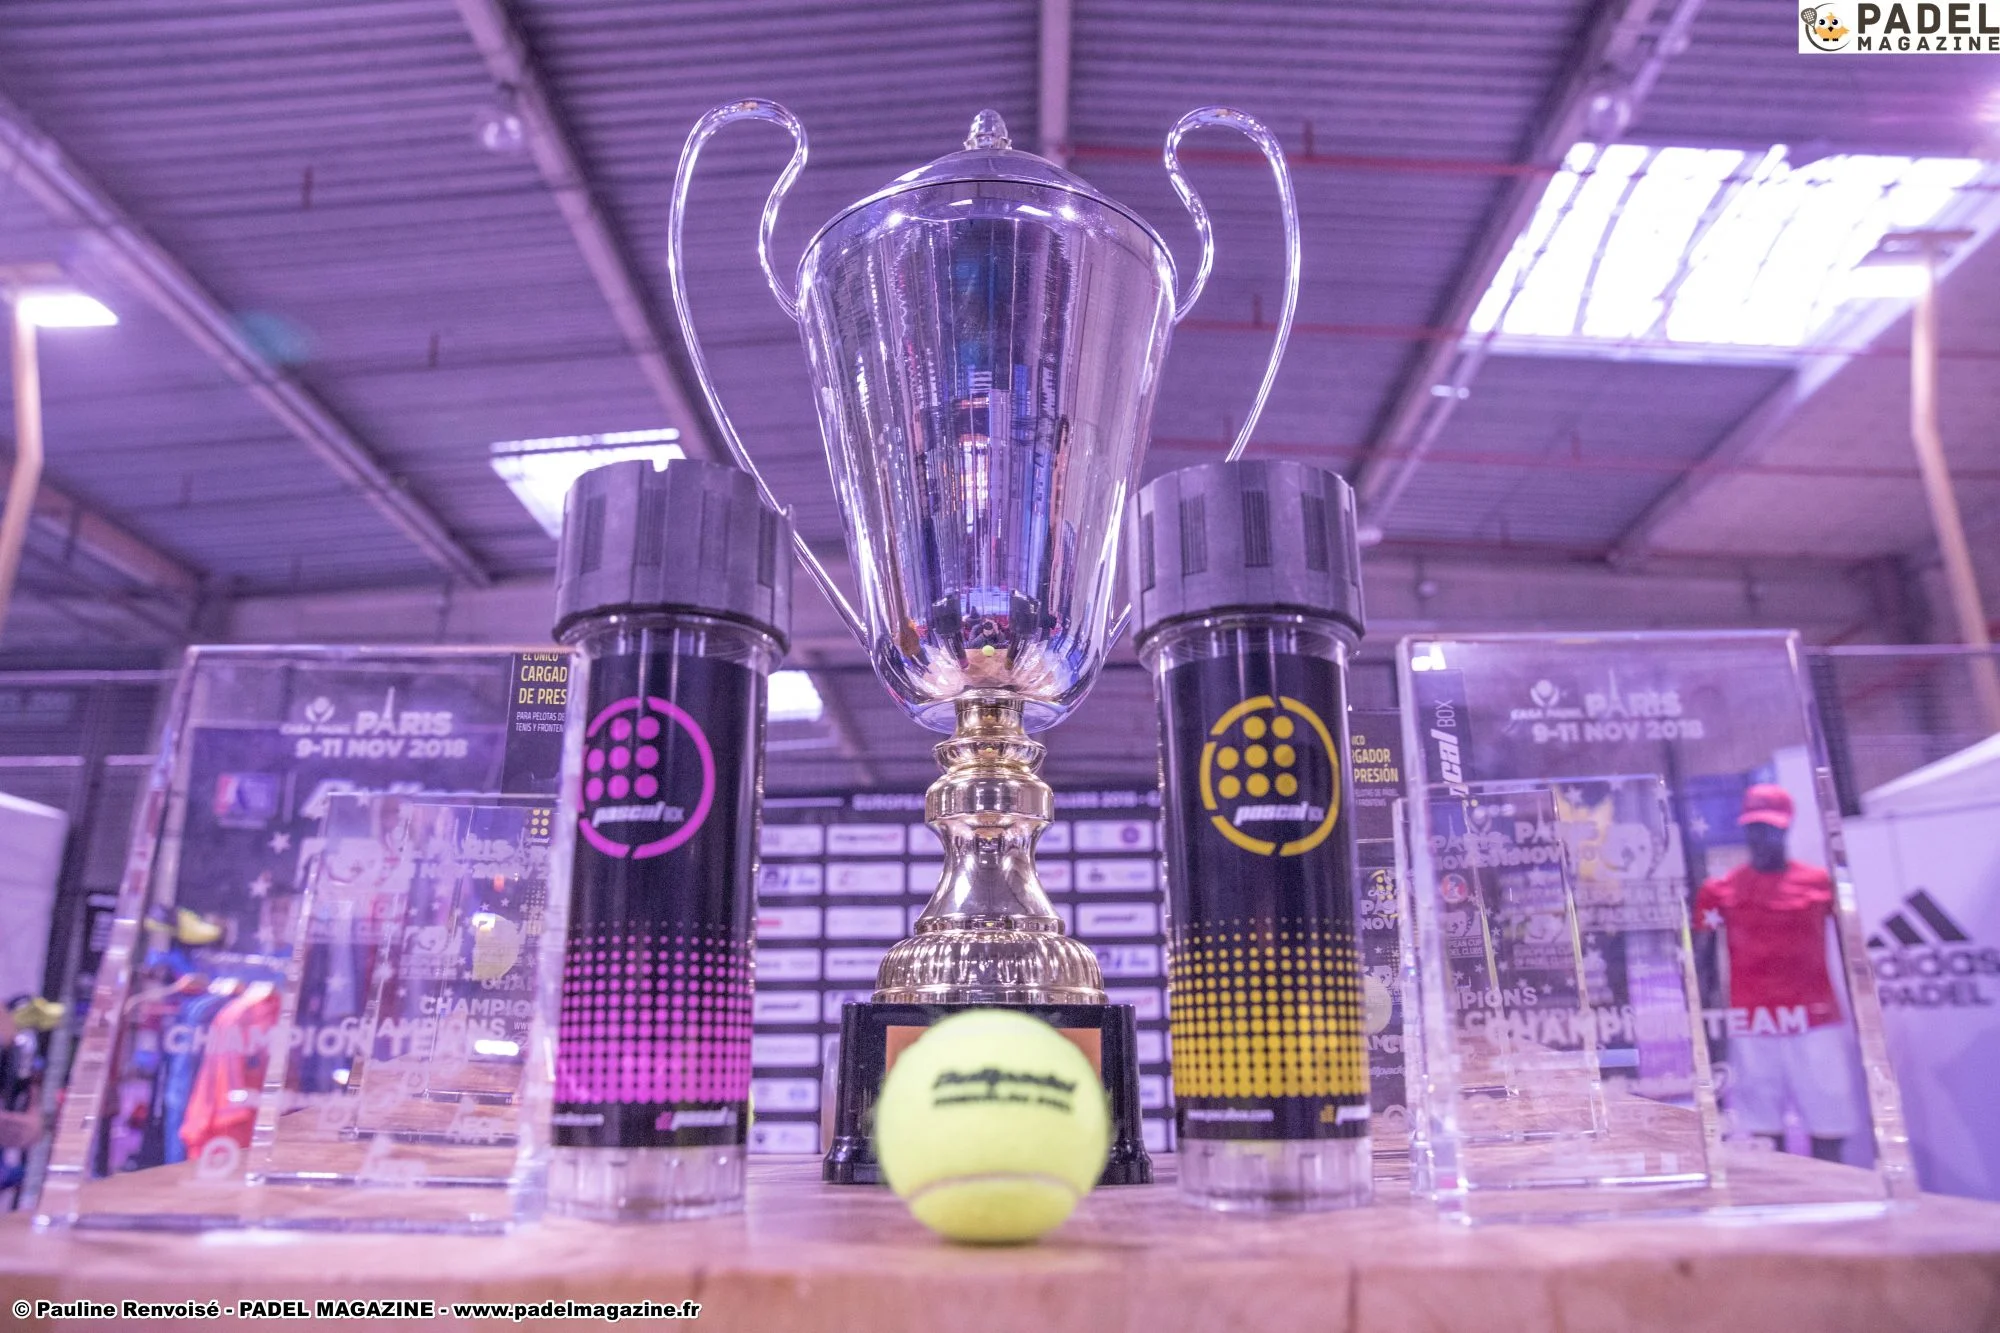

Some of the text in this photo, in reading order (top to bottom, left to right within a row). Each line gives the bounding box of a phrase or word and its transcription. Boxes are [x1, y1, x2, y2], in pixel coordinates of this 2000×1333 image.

[521, 665, 568, 682] CARGAD
[518, 687, 567, 705] DE PRES
[355, 698, 453, 736] PARIS
[516, 711, 532, 721] PARA
[532, 711, 557, 721] PELOTAS
[1434, 700, 1456, 728] BOX
[515, 722, 532, 732] TENIS
[1584, 721, 1640, 741] NOV
[347, 739, 405, 758] NOV
[1354, 764, 1399, 783] PRESIÓN
[1704, 1004, 1809, 1038] TEAM
